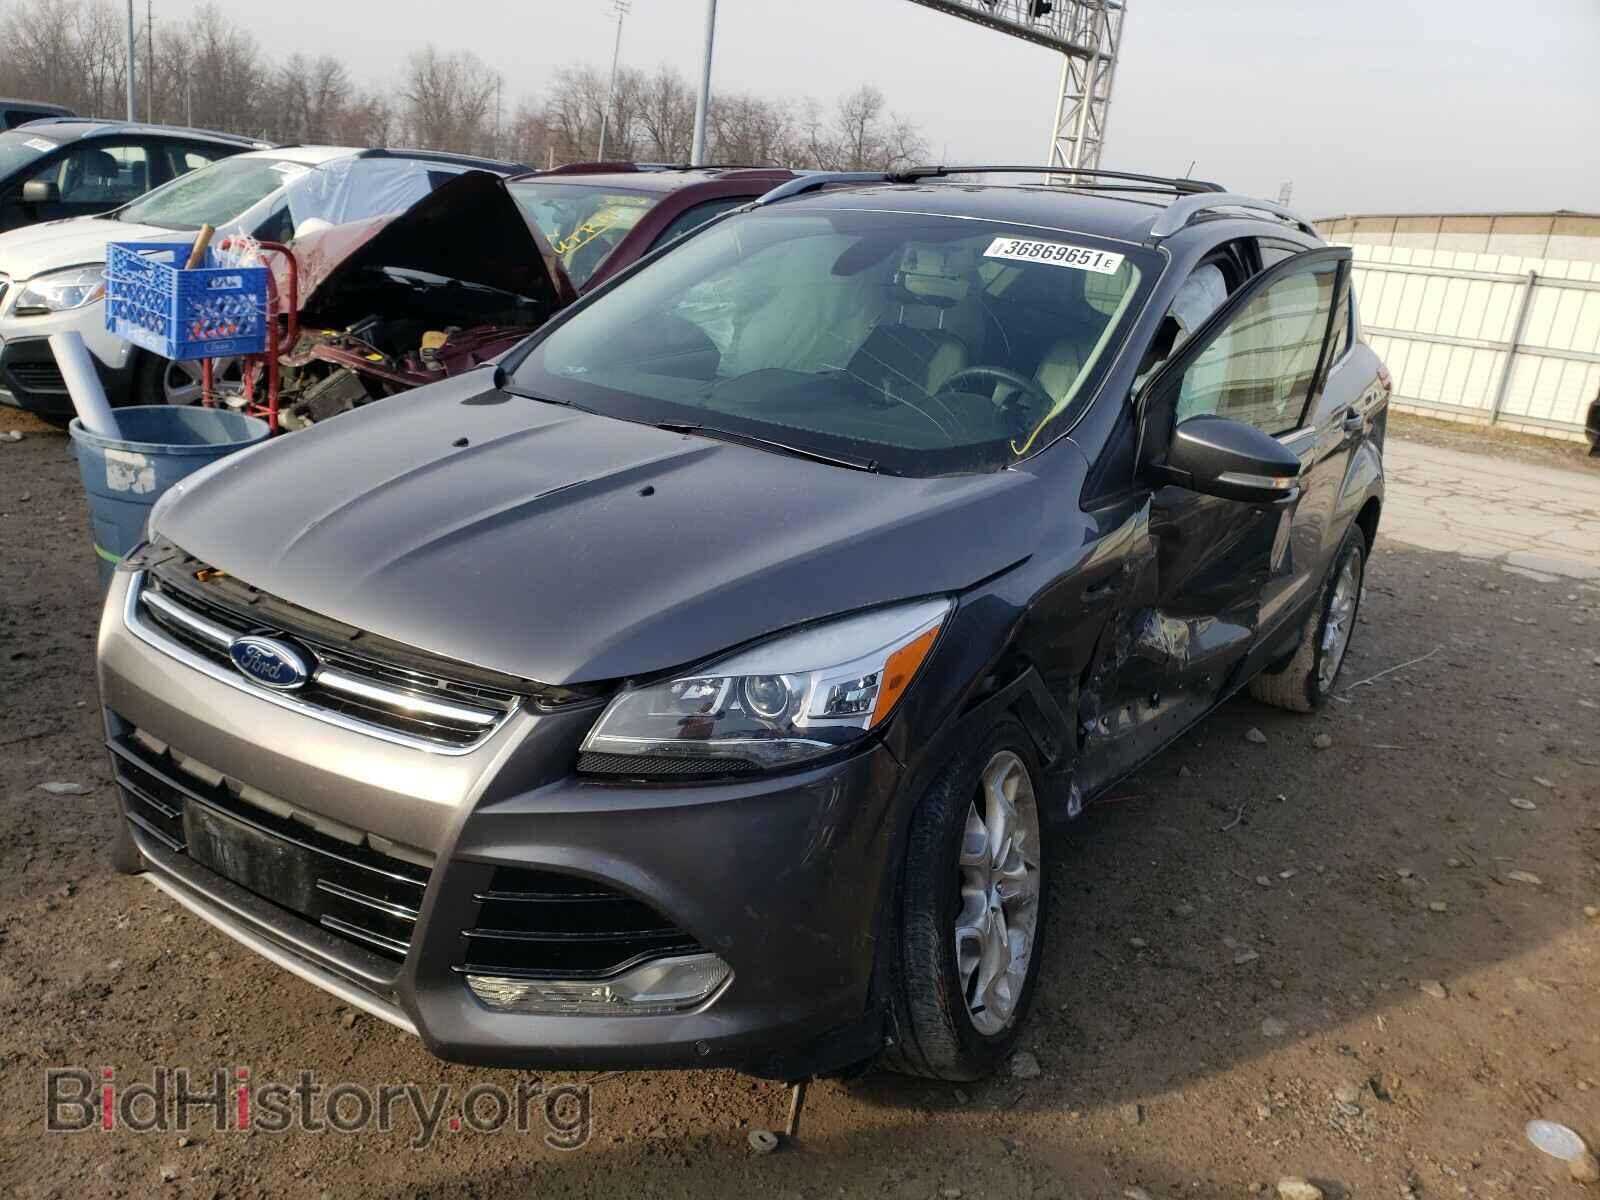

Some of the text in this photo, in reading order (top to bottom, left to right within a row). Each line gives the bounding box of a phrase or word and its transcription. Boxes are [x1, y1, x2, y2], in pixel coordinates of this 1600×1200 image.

[1004, 241, 1104, 267] 36869651
[1104, 259, 1115, 268] E
[240, 645, 282, 680] Ford
